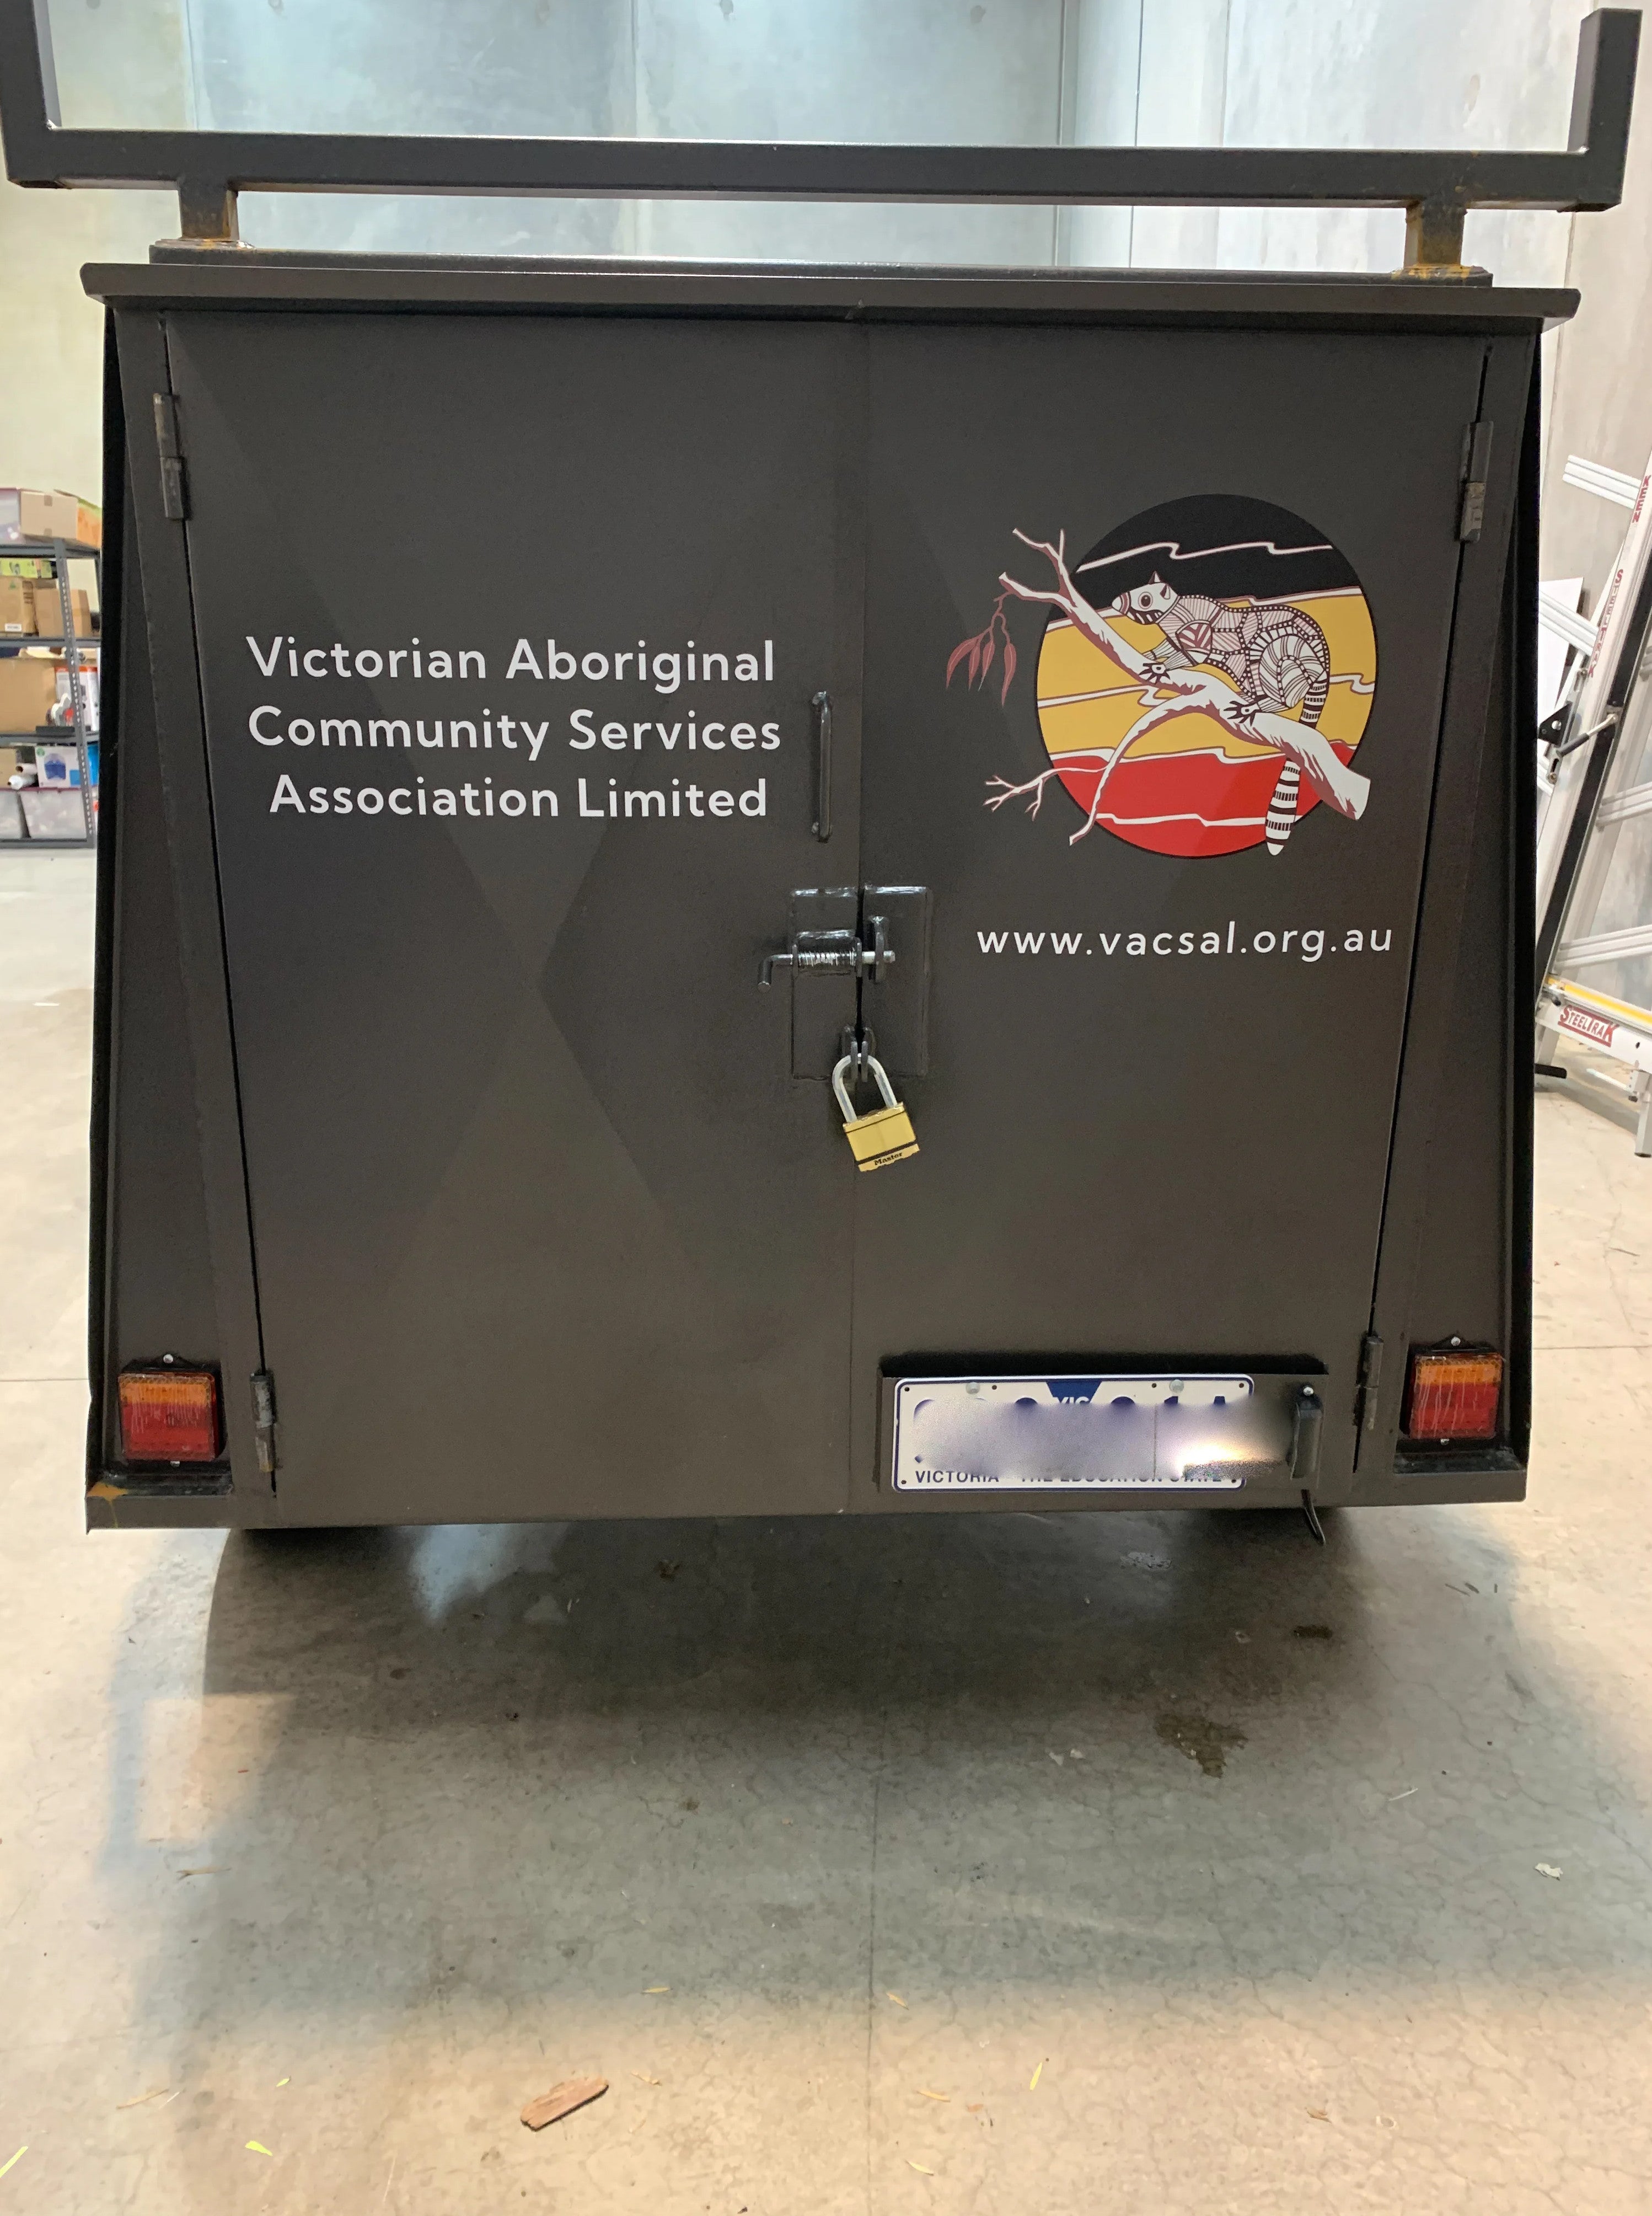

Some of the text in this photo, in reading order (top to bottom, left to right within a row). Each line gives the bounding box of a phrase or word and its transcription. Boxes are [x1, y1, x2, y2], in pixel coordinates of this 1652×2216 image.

[1632, 475, 1651, 523] KEEN
[245, 636, 773, 694] Victorian Aboriginal
[249, 705, 781, 761] Community Services
[269, 774, 766, 817] Association Limited
[977, 920, 1392, 962] www.vacsal.org.au
[874, 1153, 902, 1165] Master
